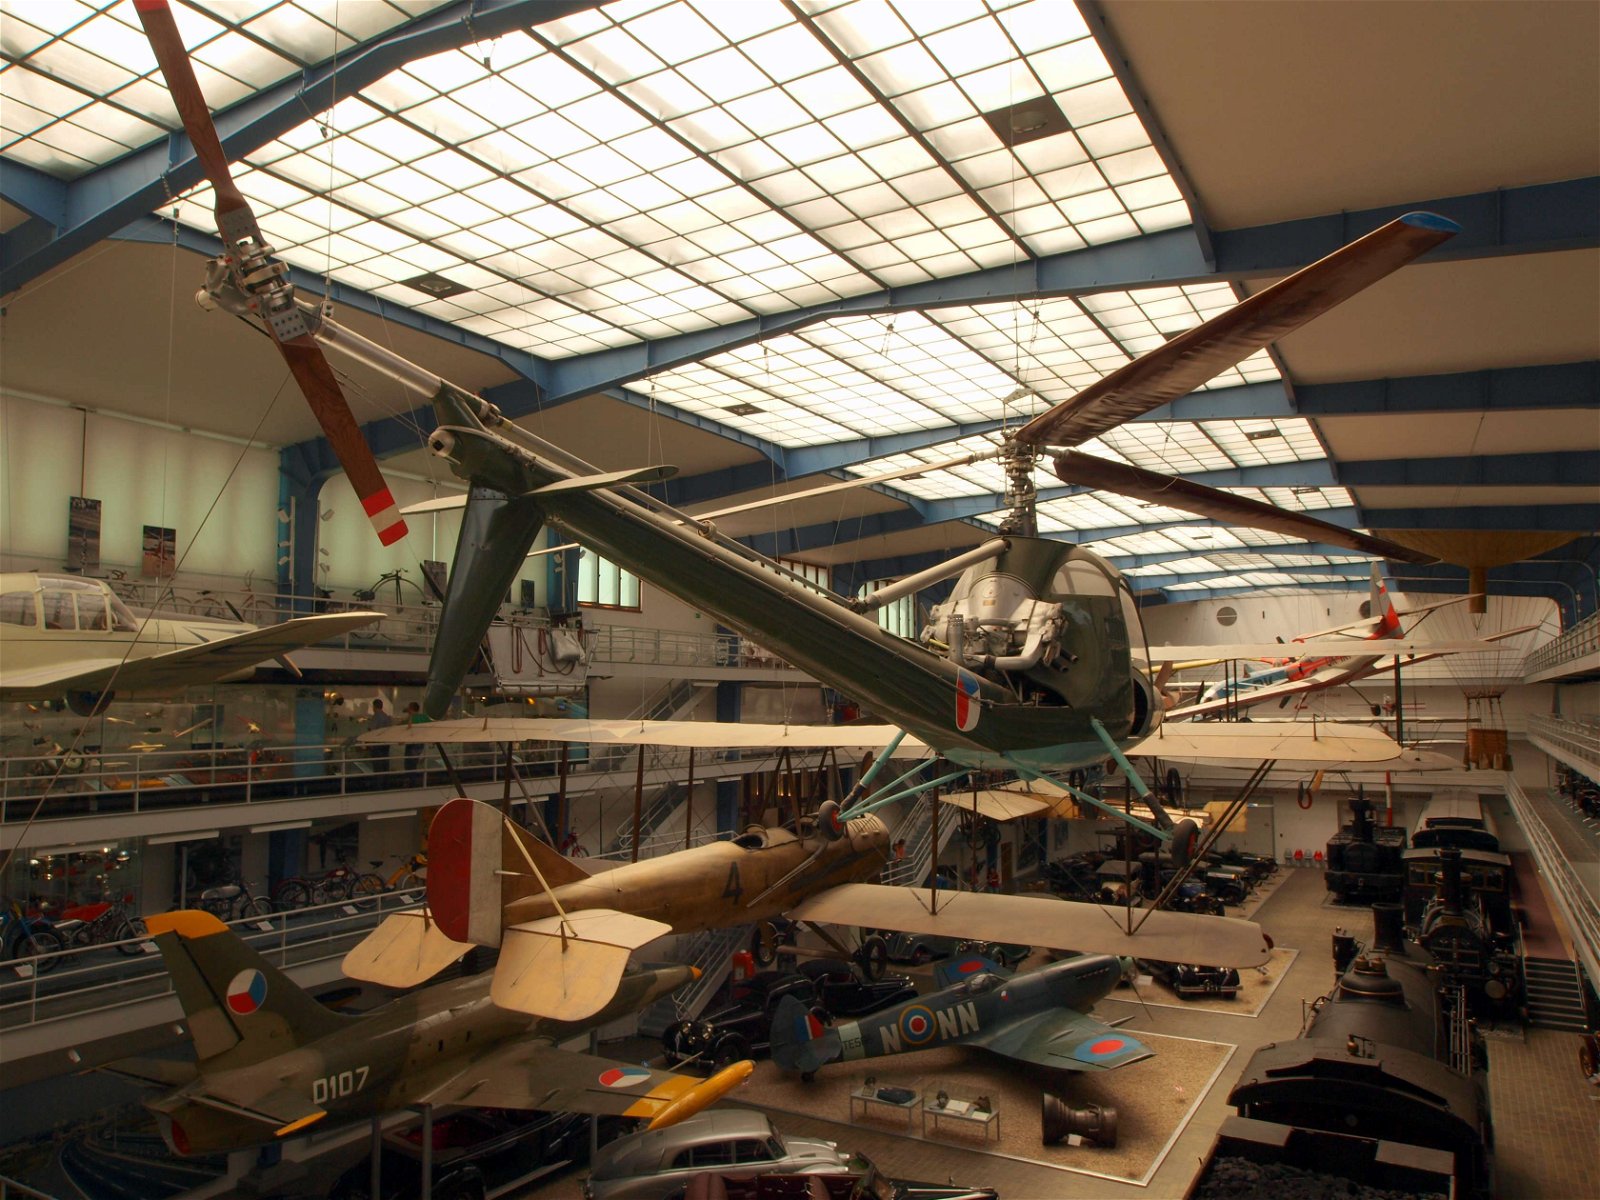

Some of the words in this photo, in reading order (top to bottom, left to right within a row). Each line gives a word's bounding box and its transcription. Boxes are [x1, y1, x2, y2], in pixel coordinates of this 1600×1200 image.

[722, 861, 745, 905] 4
[879, 1023, 902, 1055] N
[936, 1001, 980, 1040] NN
[312, 1065, 370, 1105] 0107
